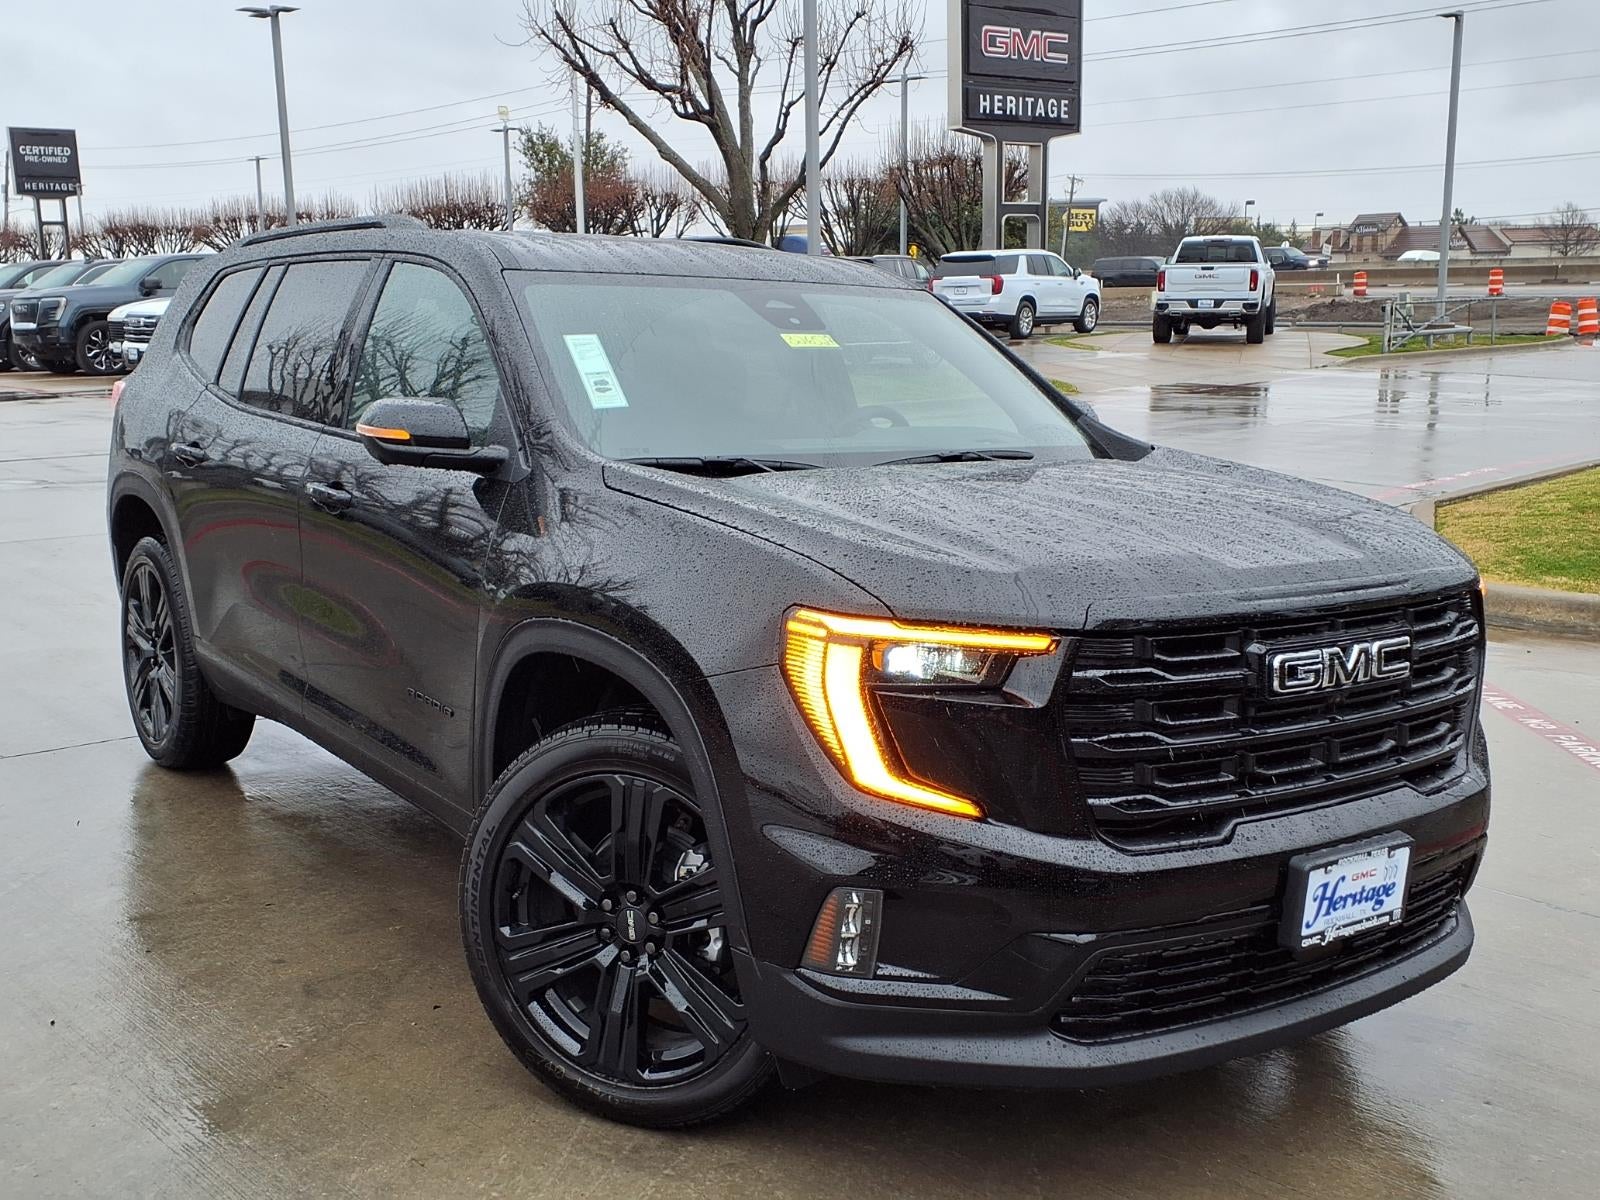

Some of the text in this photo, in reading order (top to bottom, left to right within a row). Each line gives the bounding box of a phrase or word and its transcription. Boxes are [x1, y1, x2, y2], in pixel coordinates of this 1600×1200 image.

[982, 25, 1069, 64] GMC
[980, 94, 1069, 118] HERITAGE
[19, 145, 71, 156] CERTIFIED
[25, 155, 68, 163] PRE-OWNED
[24, 182, 75, 191] HERITAGE
[1272, 635, 1411, 693] GMC
[1352, 869, 1377, 881] GMC
[1305, 874, 1397, 929] Heritage
